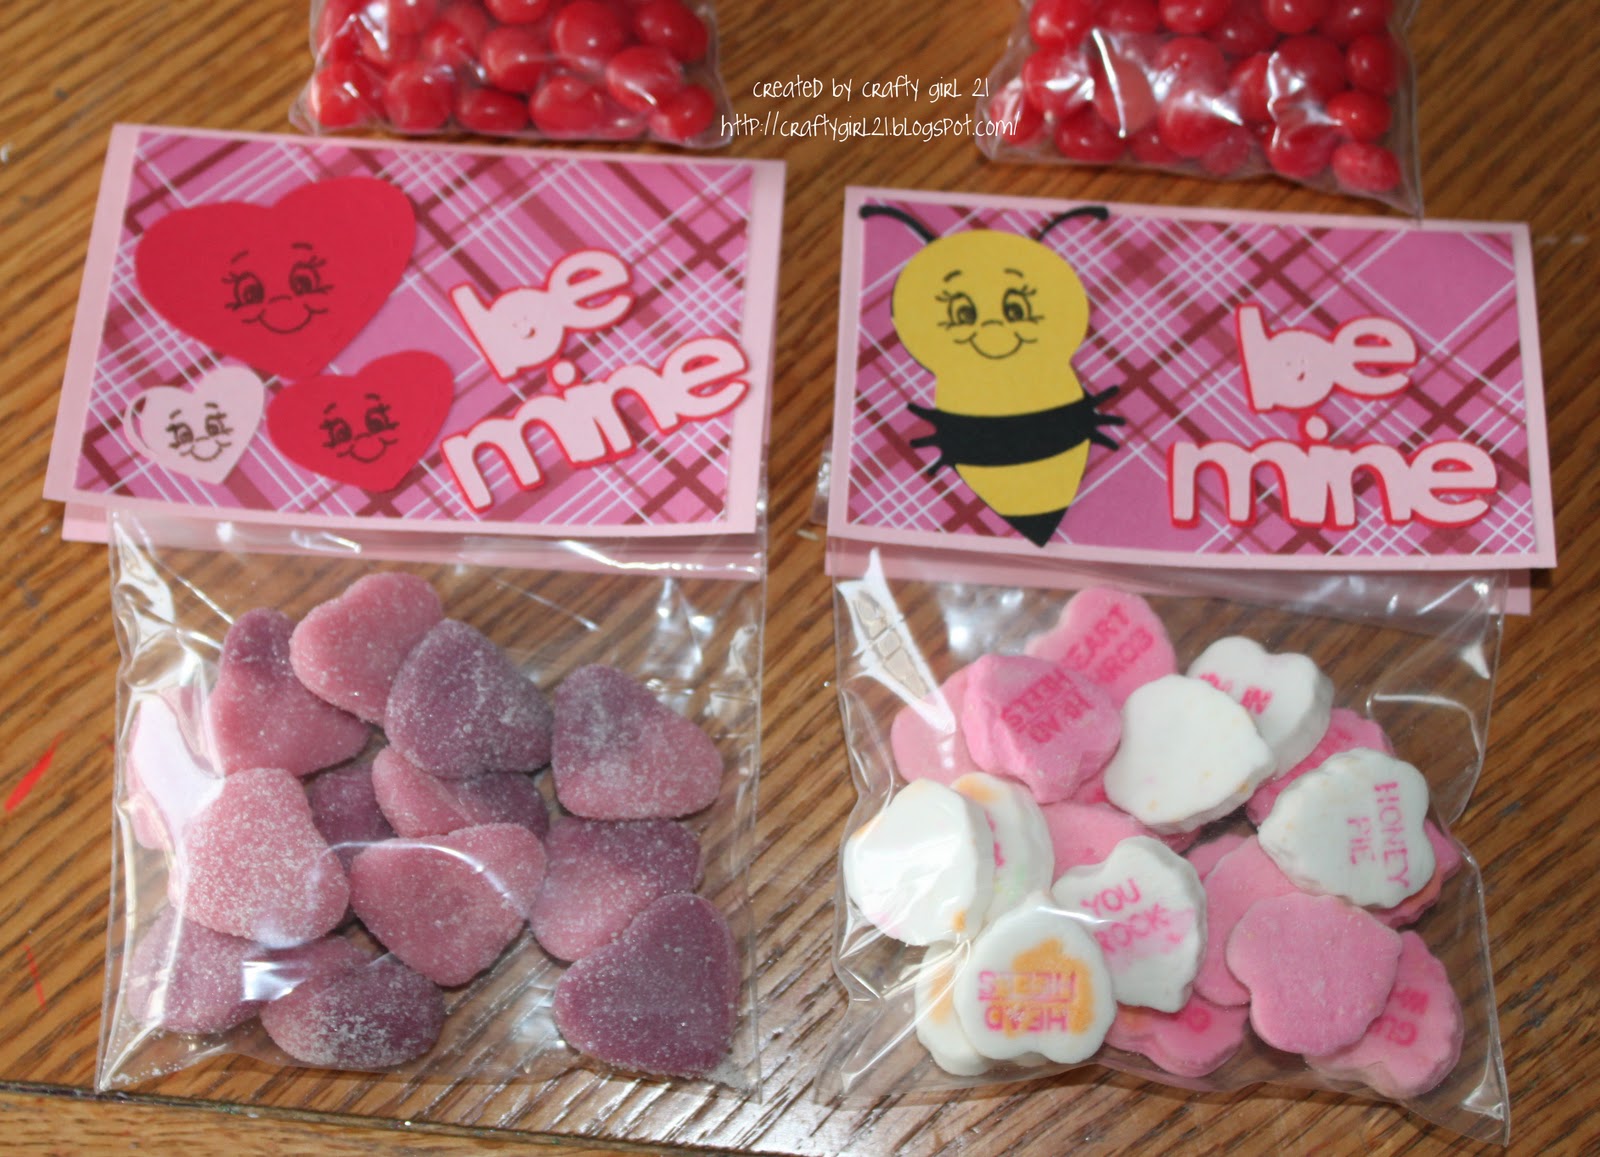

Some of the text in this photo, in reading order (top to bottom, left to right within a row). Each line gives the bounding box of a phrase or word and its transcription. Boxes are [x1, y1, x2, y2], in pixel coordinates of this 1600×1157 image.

[449, 248, 637, 383] be
[1235, 302, 1420, 414] be
[440, 336, 751, 514] mine
[1167, 408, 1499, 530] mine
[1347, 817, 1377, 866] PIE
[1374, 781, 1411, 889] HONEY
[1080, 878, 1143, 916] YOU
